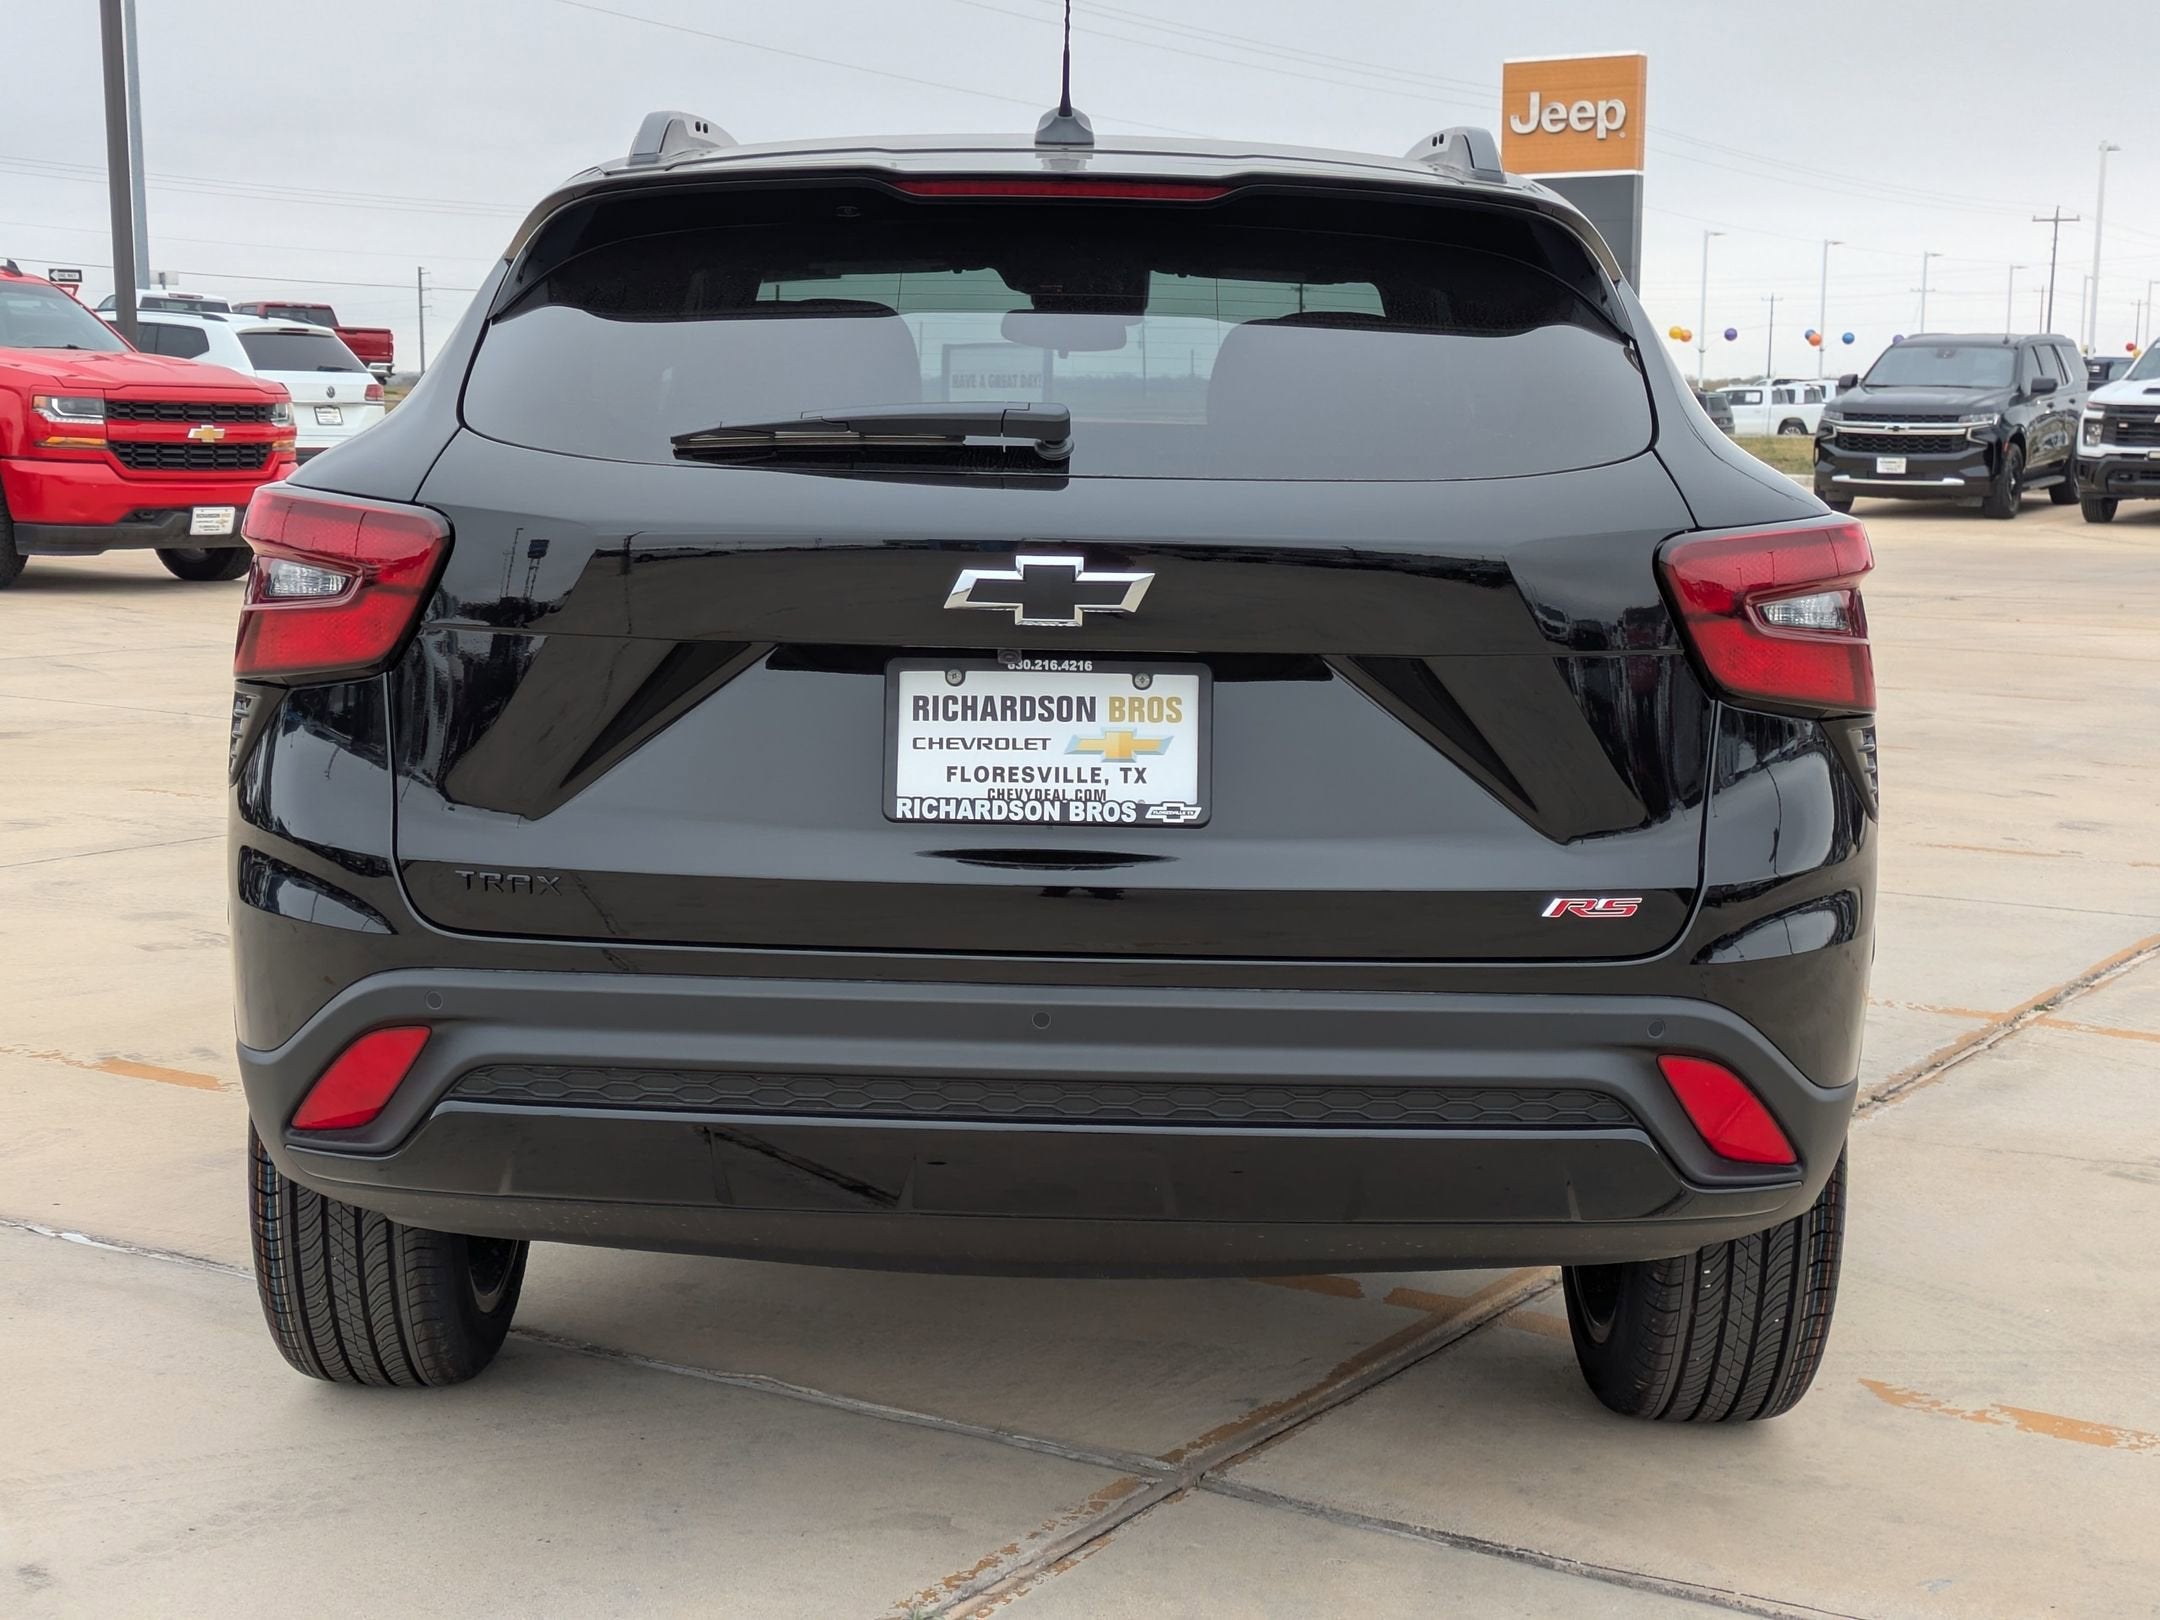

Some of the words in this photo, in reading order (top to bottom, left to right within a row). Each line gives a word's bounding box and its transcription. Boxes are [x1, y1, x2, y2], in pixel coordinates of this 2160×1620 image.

[1510, 91, 1627, 140] Jeep
[912, 695, 1096, 722] RICHARDSON
[1108, 696, 1183, 723] BROS
[912, 737, 1051, 750] CHEVROLET
[946, 766, 1109, 786] FLORESVILLE,
[1119, 767, 1148, 784] TX
[987, 788, 1107, 801] CHEVYDEAL.COM
[896, 798, 1061, 821] RICHARDSON
[1068, 801, 1137, 823] BROS
[455, 870, 562, 896] TRAX
[1541, 898, 1643, 917] RS
